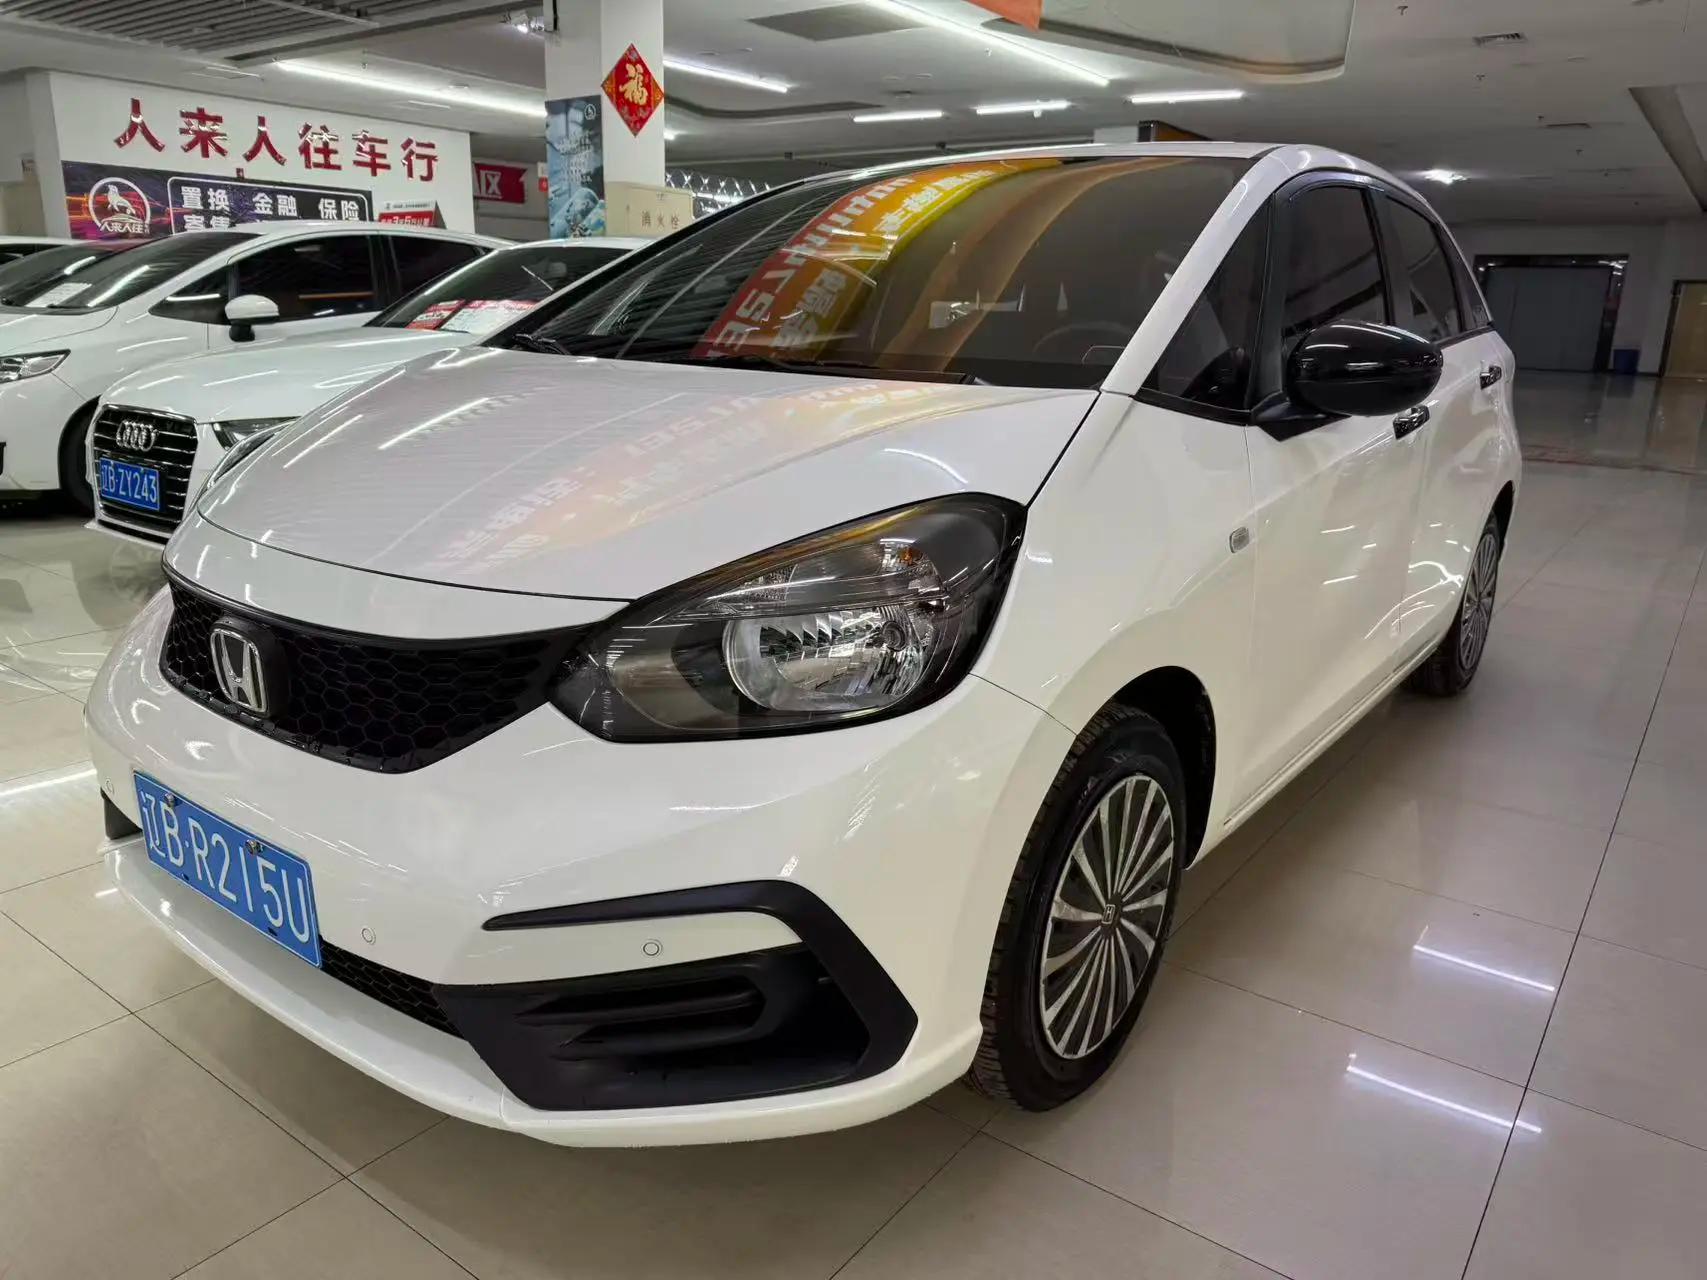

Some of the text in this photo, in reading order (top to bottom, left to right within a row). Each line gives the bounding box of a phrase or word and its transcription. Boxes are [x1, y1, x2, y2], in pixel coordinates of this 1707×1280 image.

[619, 63, 648, 106] 福
[113, 97, 439, 182] 人来人往车行
[181, 186, 360, 221] 置换 金融 保险
